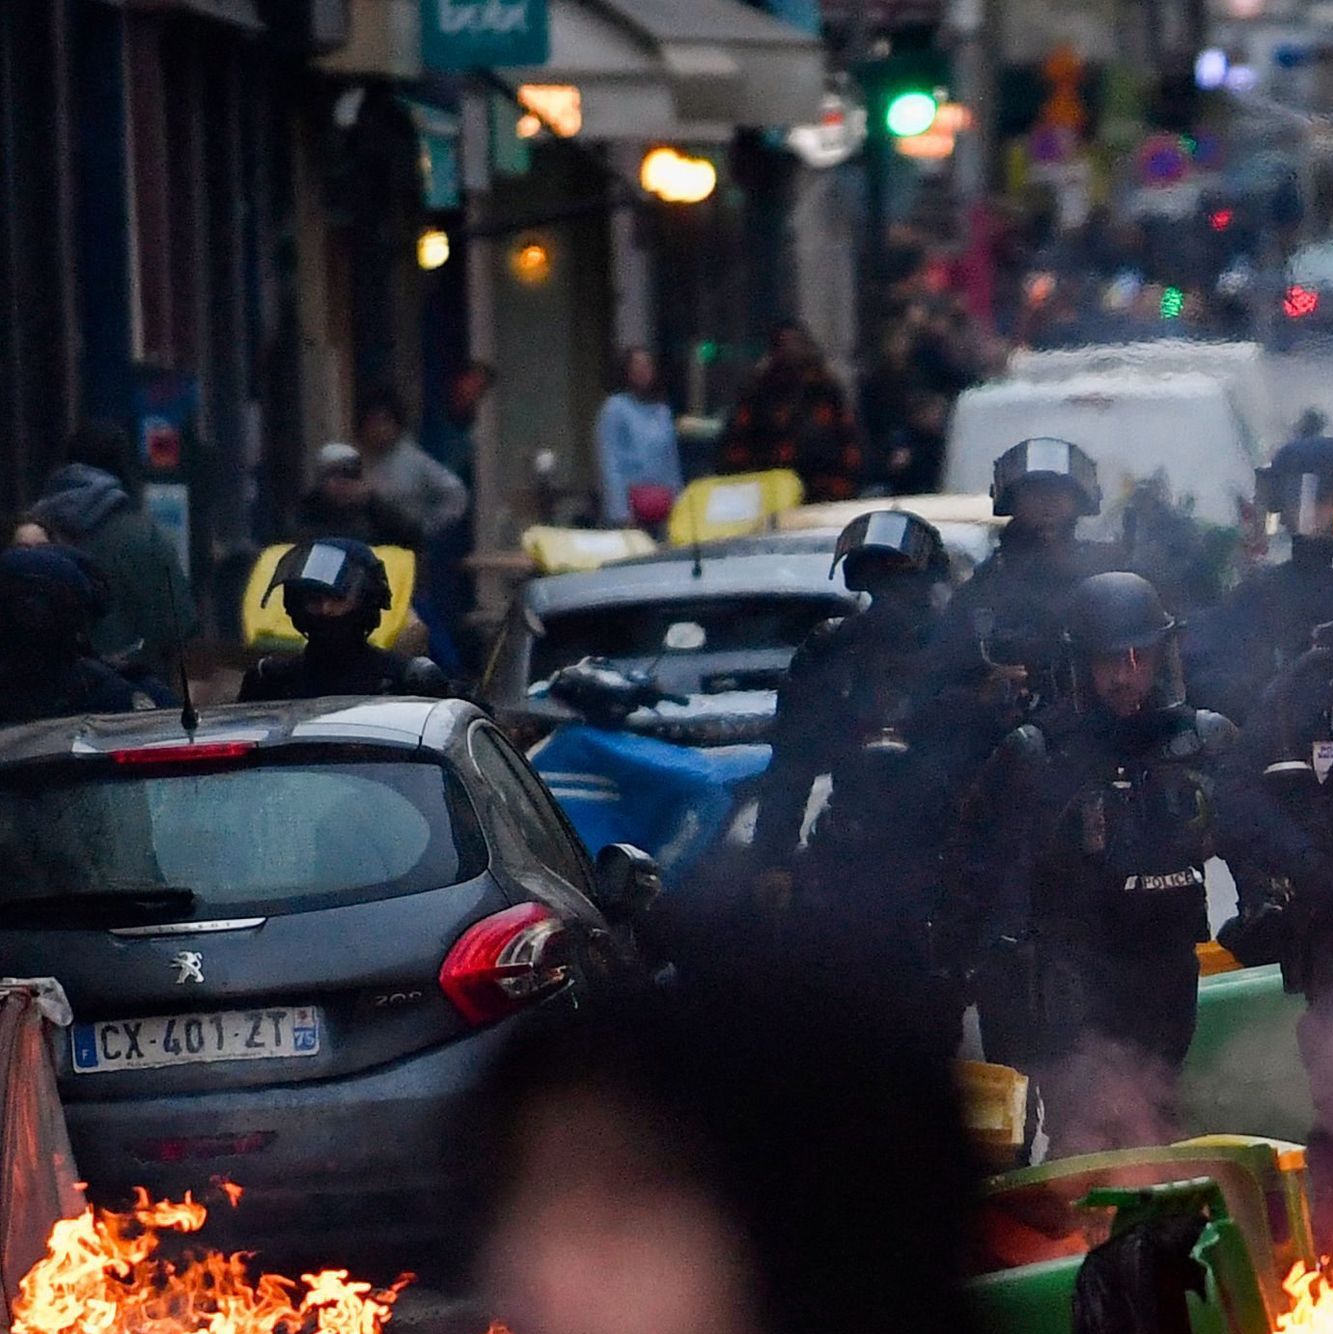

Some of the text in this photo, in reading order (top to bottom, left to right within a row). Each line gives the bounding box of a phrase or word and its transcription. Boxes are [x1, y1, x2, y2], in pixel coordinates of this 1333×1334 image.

[1142, 873, 1194, 889] POLICE
[294, 1031, 315, 1048] 75
[81, 1048, 90, 1061] F
